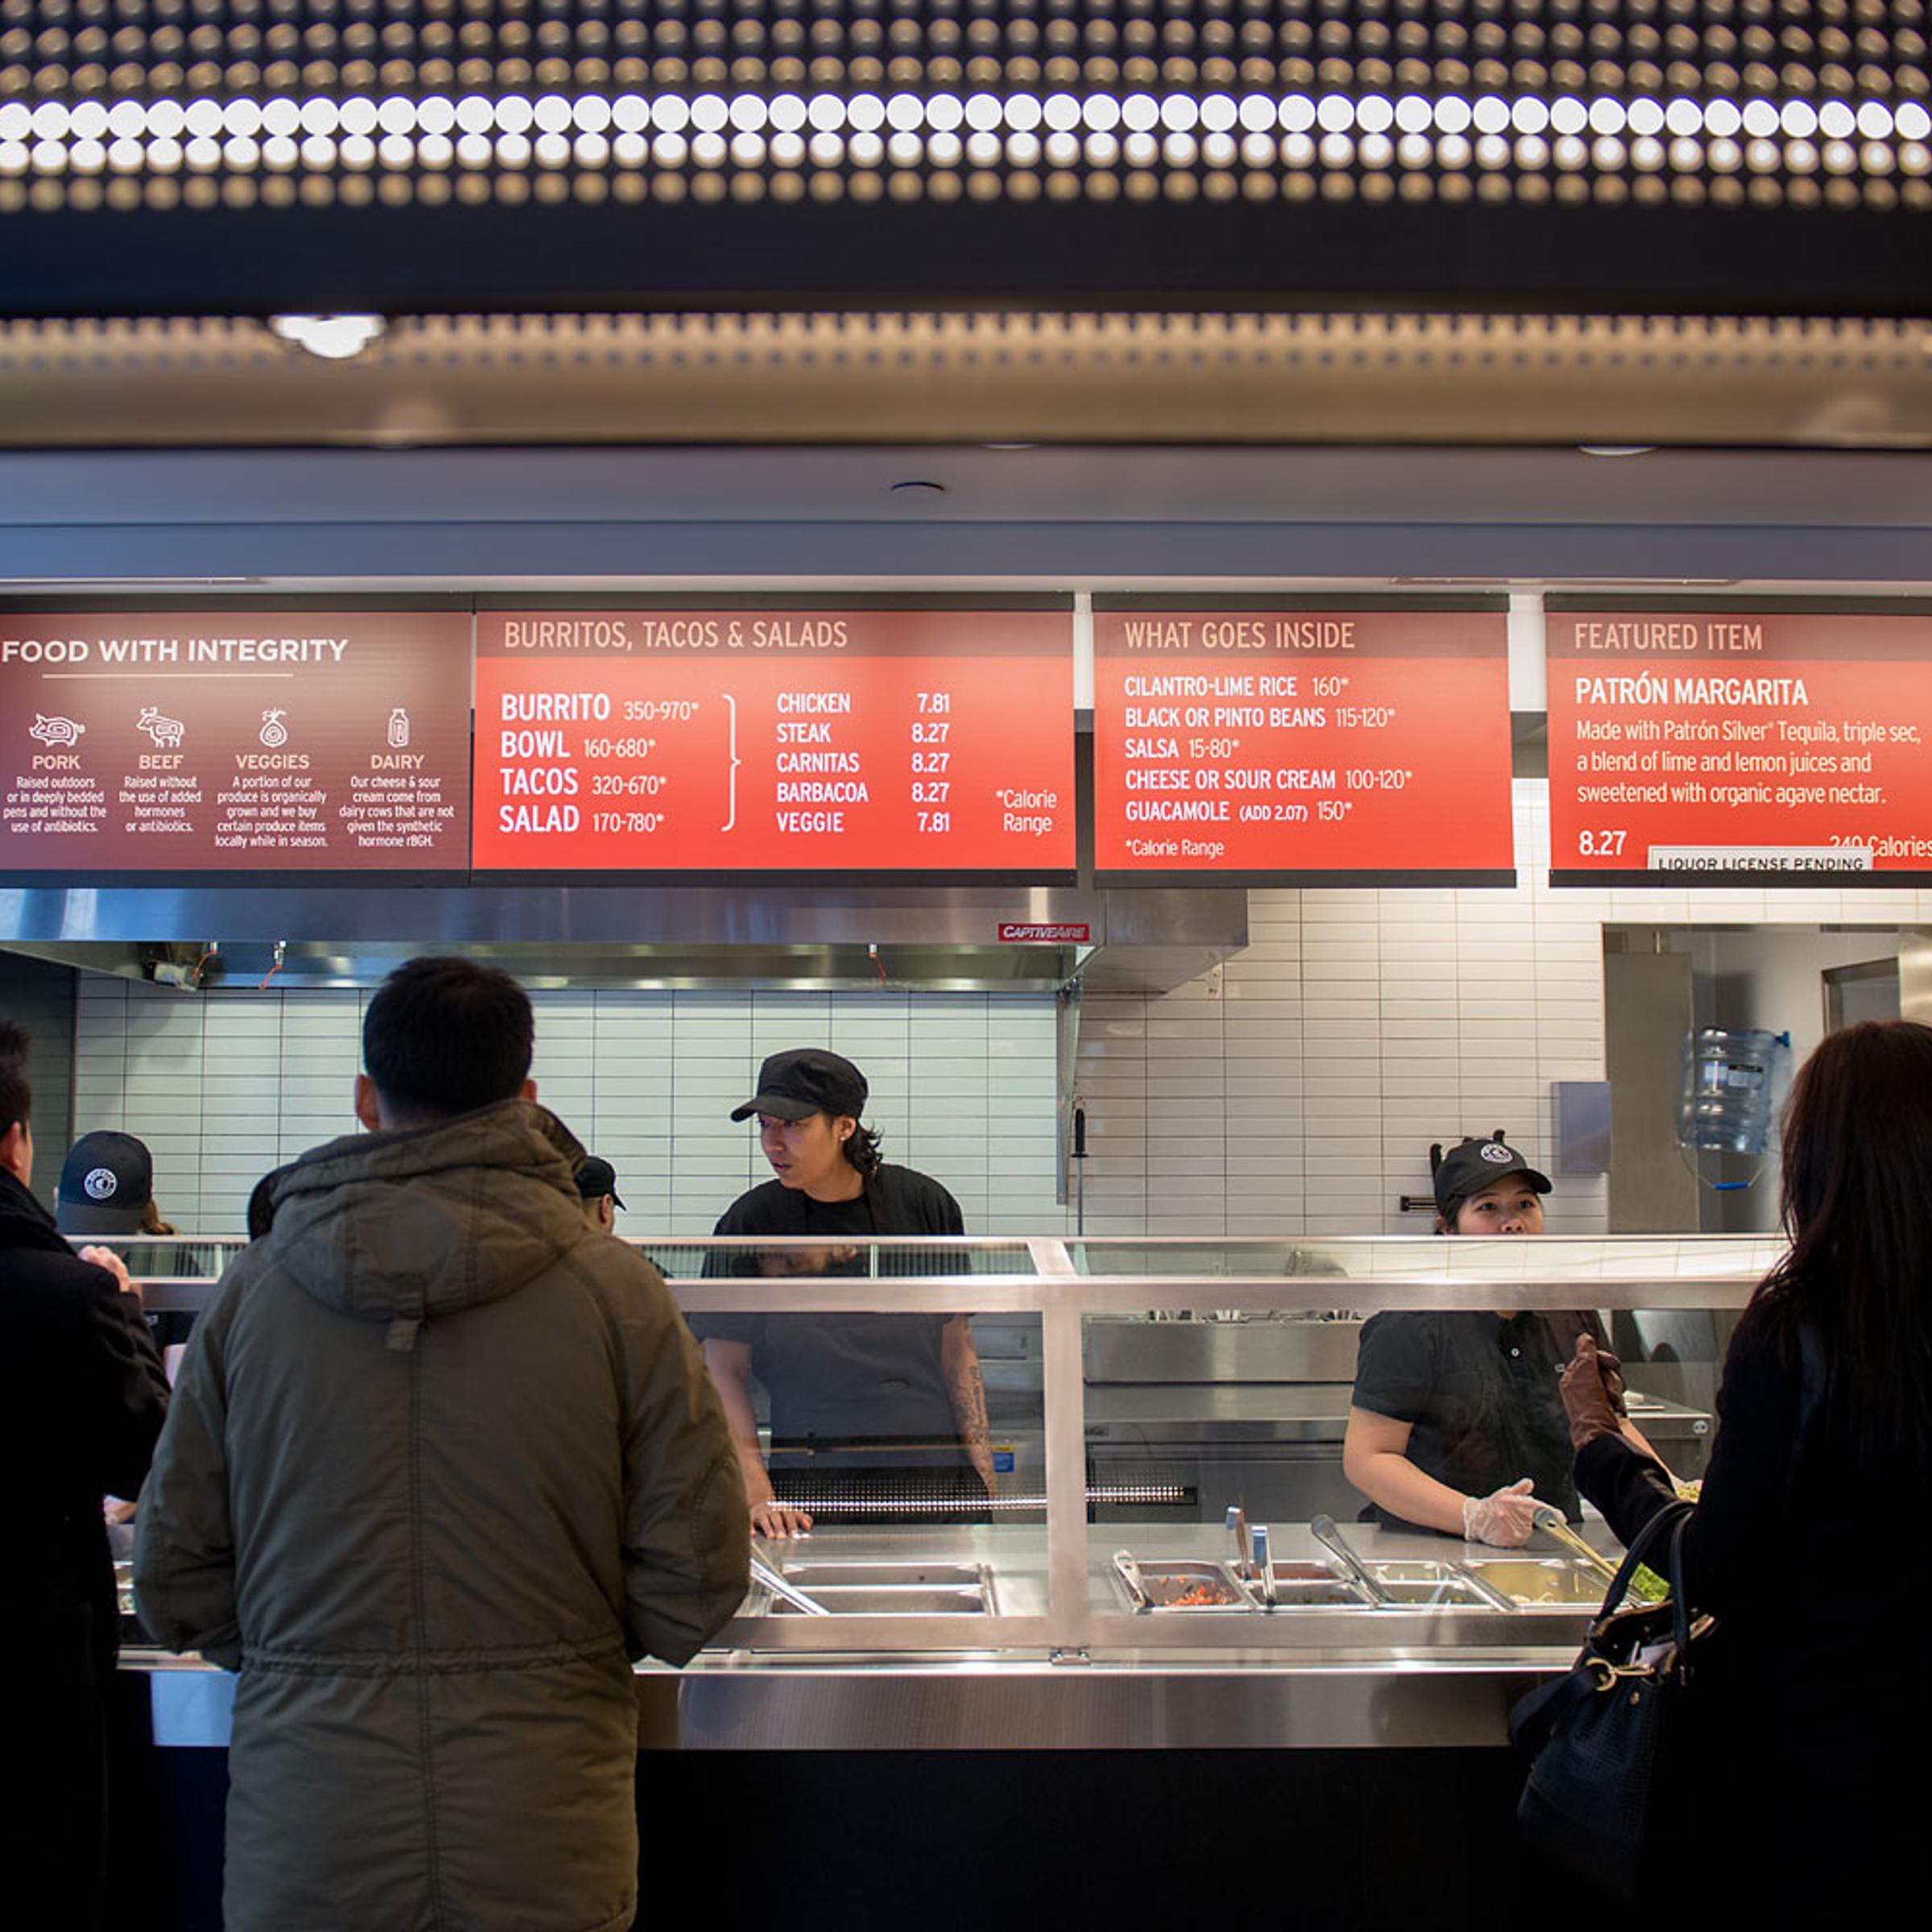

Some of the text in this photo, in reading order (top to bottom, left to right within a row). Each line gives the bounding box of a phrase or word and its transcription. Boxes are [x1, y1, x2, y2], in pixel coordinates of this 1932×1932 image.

[506, 621, 847, 652] BURRITOS, TACOS & SALADS
[1125, 622, 1355, 648] WHAT GOES INSIDE
[1575, 624, 1761, 650] FEATURED ITEM
[3, 639, 348, 662] FOOD WITH INTEGRITY
[1125, 676, 1254, 696] CILANTRO-LIME
[1260, 677, 1297, 696] RICE
[1576, 671, 1808, 705] PATRÓN MARGARITA
[502, 693, 610, 720] BURRITO
[778, 693, 949, 712] CHICKEN 7.81
[1125, 708, 1180, 727] BLACK
[1185, 708, 1209, 727] OR
[1215, 708, 1264, 727] PINTO
[1270, 708, 1325, 727] BEANS
[777, 723, 949, 742] STEAK 8.27
[1577, 720, 1621, 740] Made
[1624, 720, 1660, 740] with
[1665, 720, 1718, 740] Patrón
[1777, 720, 1839, 745] Tequila,
[1843, 721, 1886, 745] triple
[1889, 726, 1921, 743] sec,
[502, 731, 570, 758] BOWL
[1125, 738, 1179, 758] SALSA
[33, 755, 80, 770] PORK
[139, 755, 184, 769] BEEF
[236, 755, 309, 769] VEGGIES
[371, 755, 424, 769] DAIRY
[777, 753, 950, 773] CARNITAS 8.27
[1577, 750, 1871, 776] a blend of lime and lemon juices and
[17, 777, 96, 788] Raised outdoors
[125, 776, 196, 788] Raised without
[233, 775, 312, 789] A portion of our
[351, 776, 369, 787] Our
[371, 777, 407, 788] cheese
[419, 778, 440, 788] sour
[500, 768, 578, 795] TACOS
[1125, 770, 1191, 789] CHEESE
[1195, 770, 1219, 789] OR
[1224, 770, 1271, 789] SOUR
[1277, 770, 1335, 789] CREAM
[7, 791, 104, 804] or in deeply bedded
[119, 791, 201, 803] the use of added
[217, 791, 326, 804] produce is organically
[353, 791, 440, 803] cream come from
[778, 782, 949, 802] BARBACOA 8.27
[1578, 782, 1886, 807] sweetened with organic agave nectar.
[3, 806, 106, 819] pens and without the
[135, 806, 185, 817] hormones
[227, 806, 316, 819] grown and we buy
[339, 805, 454, 819] dairy cows that are not
[500, 805, 580, 832] SALAD
[1126, 801, 1230, 821] GUACAMOLE
[1240, 805, 1271, 821] (ADD
[1275, 805, 1307, 821] 2.07)
[11, 820, 97, 832] use of antibiotics.
[126, 820, 193, 832] or antibiotics.
[217, 820, 325, 833] certain produce items
[347, 820, 442, 834] given the synthetic
[776, 812, 949, 832] VEGGIE 7.81
[1004, 813, 1052, 836] Range
[215, 835, 328, 848] locally while in season.
[359, 835, 404, 847] hormone
[1182, 839, 1224, 859] Range
[1579, 831, 1626, 855] 8.27
[1868, 836, 1932, 857] Calories
[1658, 857, 1863, 869] LIQUOR LICENSE PENDING
